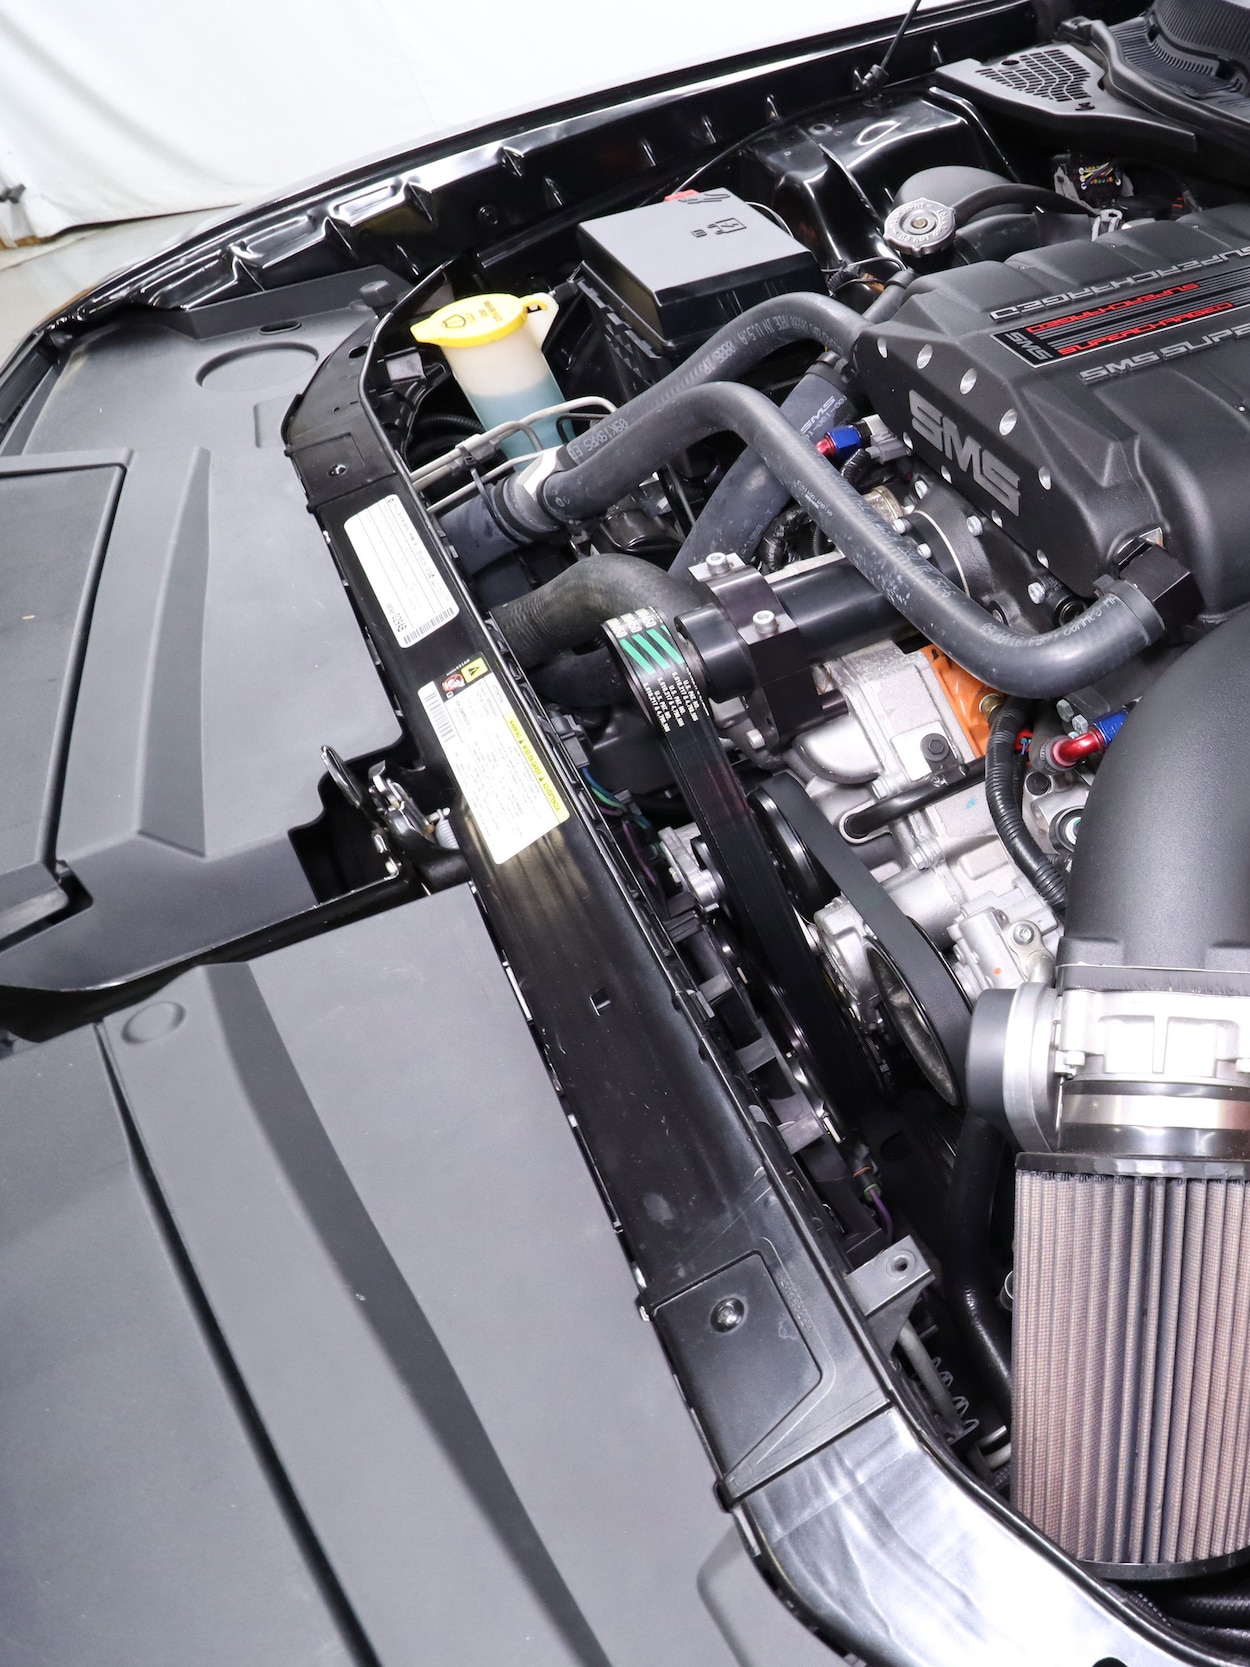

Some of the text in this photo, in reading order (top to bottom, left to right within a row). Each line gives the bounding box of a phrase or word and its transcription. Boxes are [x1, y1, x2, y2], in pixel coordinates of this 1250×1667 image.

[1026, 283, 1200, 333] SUPERCHARGED
[1058, 301, 1233, 355] SUPERCHARGED
[1004, 331, 1053, 361] SMS
[1078, 351, 1160, 385] SMS
[800, 396, 835, 434] SMS
[909, 389, 1020, 516] SMS
